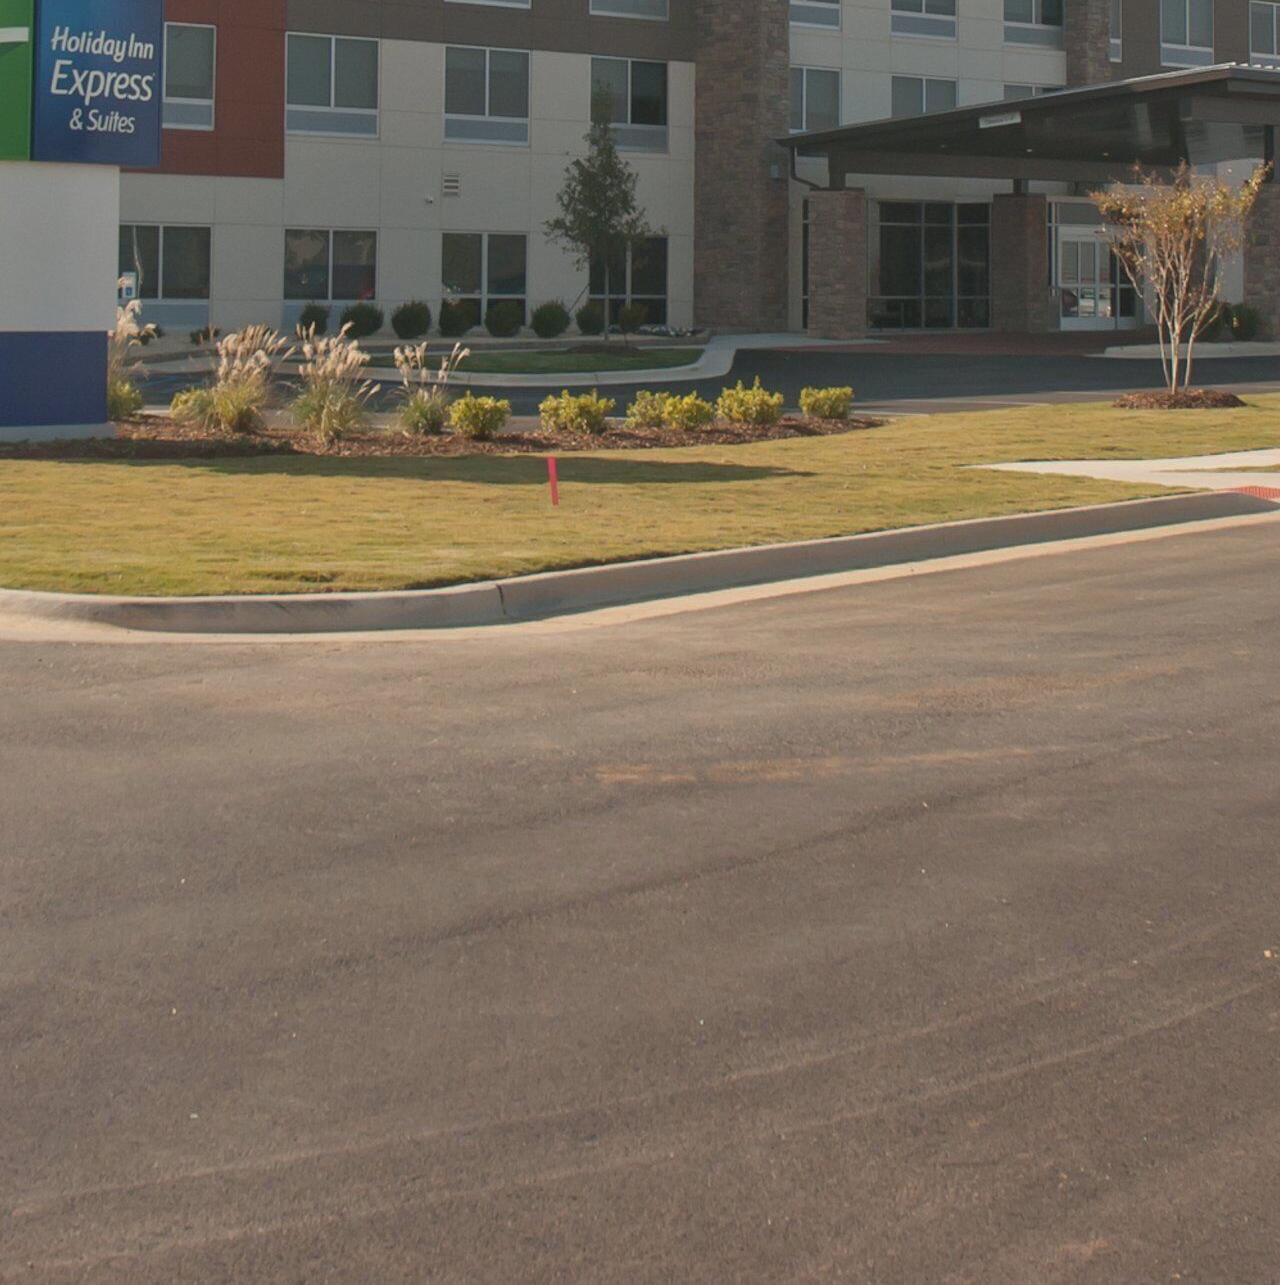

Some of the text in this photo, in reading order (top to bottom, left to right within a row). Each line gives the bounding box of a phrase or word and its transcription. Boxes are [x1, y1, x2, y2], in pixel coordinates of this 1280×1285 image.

[51, 26, 154, 62] Holiday Inn
[50, 59, 153, 106] Express
[69, 109, 135, 134] & Suites
